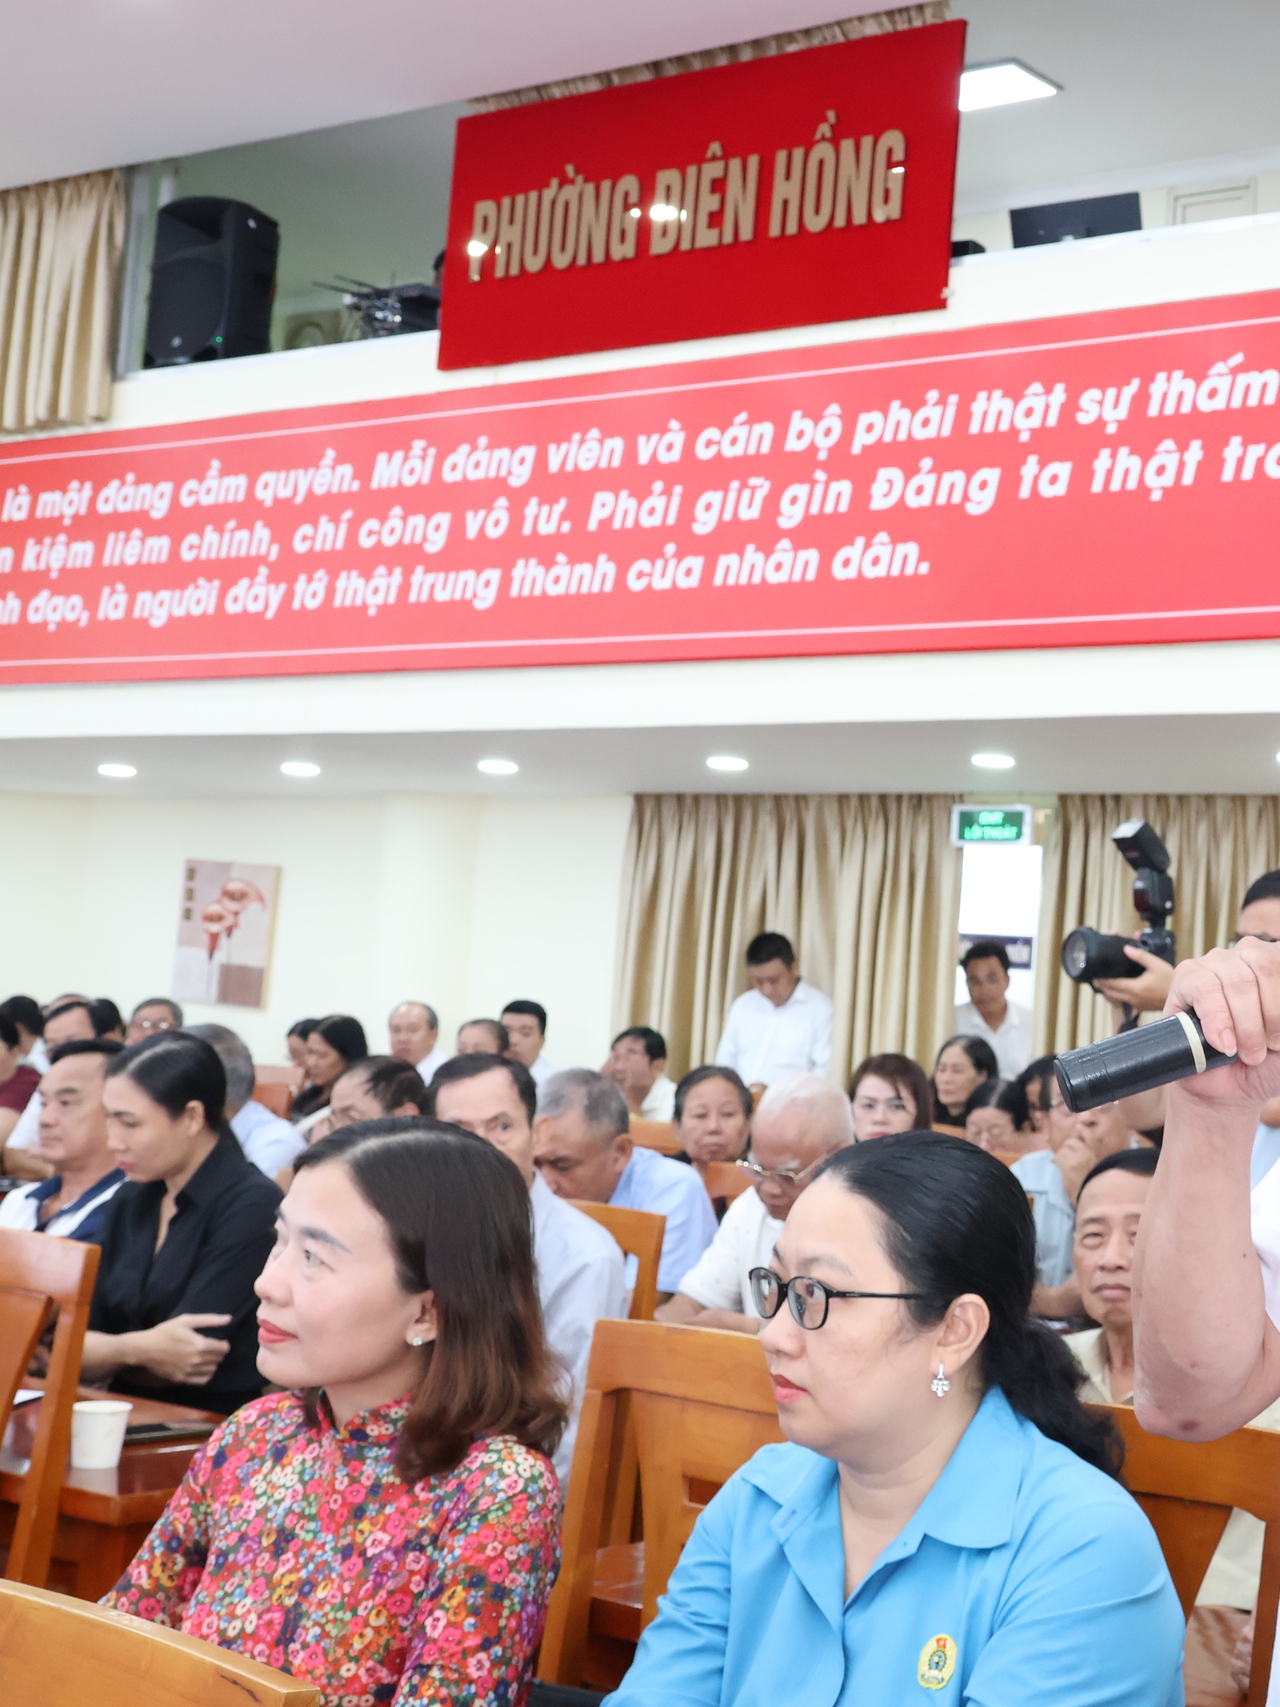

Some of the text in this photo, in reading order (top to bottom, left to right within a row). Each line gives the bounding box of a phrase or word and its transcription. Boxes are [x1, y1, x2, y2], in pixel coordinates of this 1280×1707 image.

[467, 163, 641, 284] PHƯỜNG
[768, 109, 906, 238] HỒNG
[1, 484, 31, 522] là
[35, 479, 93, 526] một
[96, 472, 172, 520] đảng
[179, 458, 248, 508] cầm
[255, 448, 360, 508] quyền.
[370, 439, 437, 490] Mỗi
[442, 435, 537, 487] đảng
[548, 428, 625, 474] viên
[637, 418, 686, 466] và
[694, 411, 774, 461] cán
[784, 402, 843, 461] bộ
[851, 388, 960, 456] phải
[969, 381, 1067, 443] thật
[1076, 377, 1141, 435] sự
[1147, 351, 1280, 418] thấm
[21, 533, 95, 579] kiệm
[102, 527, 171, 567] liêm
[179, 518, 280, 563] chính,
[292, 508, 354, 554] chí
[358, 505, 452, 554] công
[465, 495, 511, 541] vô
[521, 496, 574, 536] tư.
[586, 479, 684, 532] Phải
[691, 476, 772, 536] giữ
[776, 468, 853, 531] gìn
[869, 456, 1002, 516] Đảng
[1018, 454, 1073, 500] ta
[1090, 435, 1204, 504] thật
[26, 589, 90, 632] đạo,
[96, 582, 129, 621] là
[132, 577, 221, 629] người
[224, 564, 288, 620] đầy
[332, 564, 404, 617] thật
[407, 564, 503, 611] trung
[509, 552, 617, 598] thành
[626, 541, 705, 593] của
[712, 537, 820, 587] nhân
[831, 531, 931, 581] dân.
